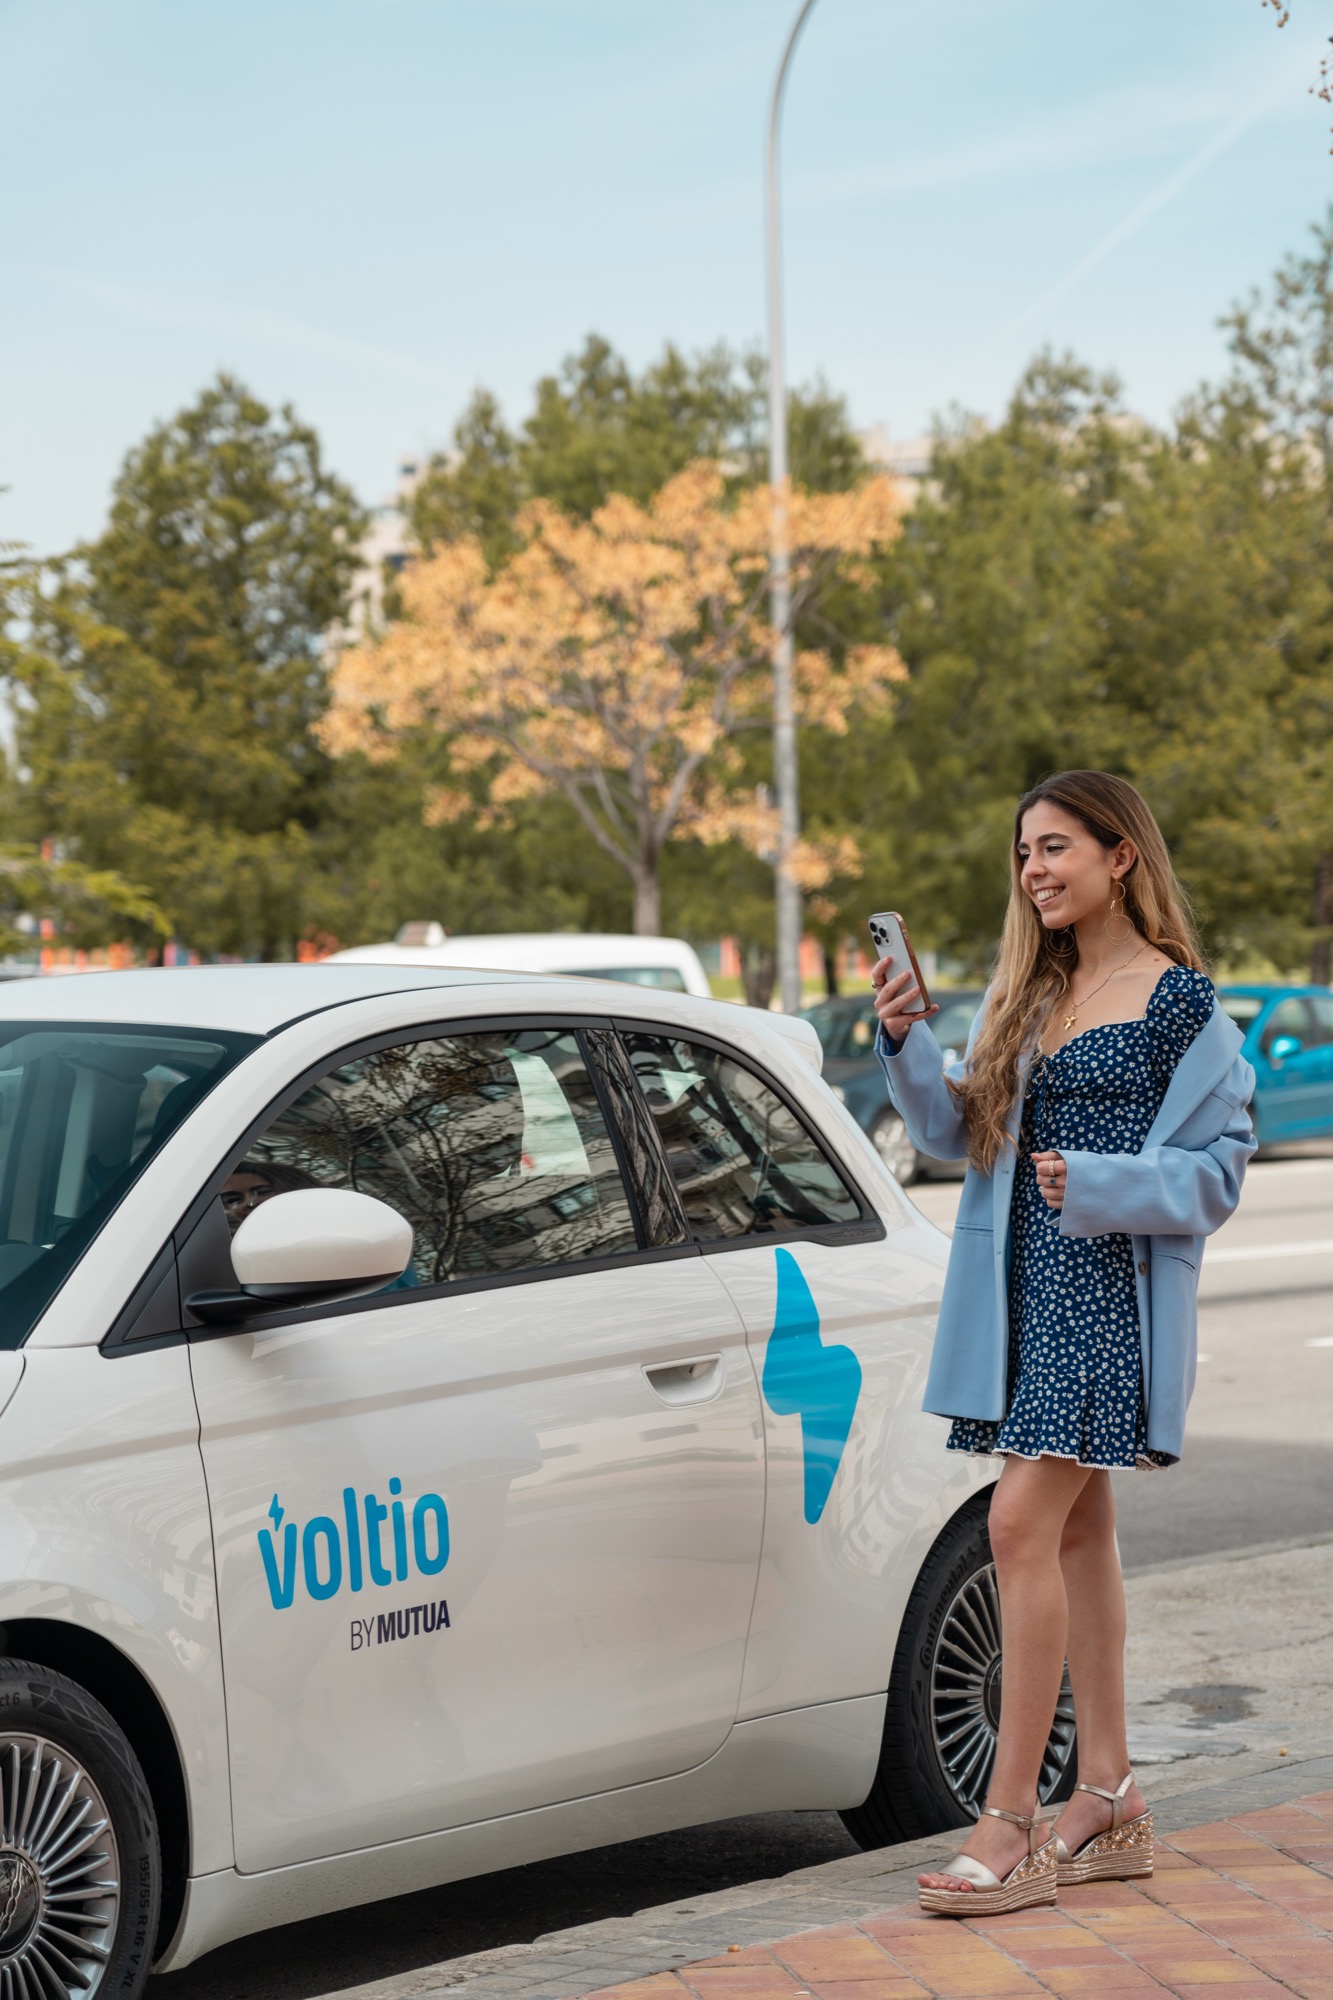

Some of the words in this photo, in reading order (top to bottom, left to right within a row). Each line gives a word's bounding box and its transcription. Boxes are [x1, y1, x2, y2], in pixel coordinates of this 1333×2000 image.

[351, 1616, 375, 1651] BY
[377, 1600, 450, 1644] MUTUA
[139, 1854, 150, 1908] 195/55
[121, 1969, 136, 1989] XL
